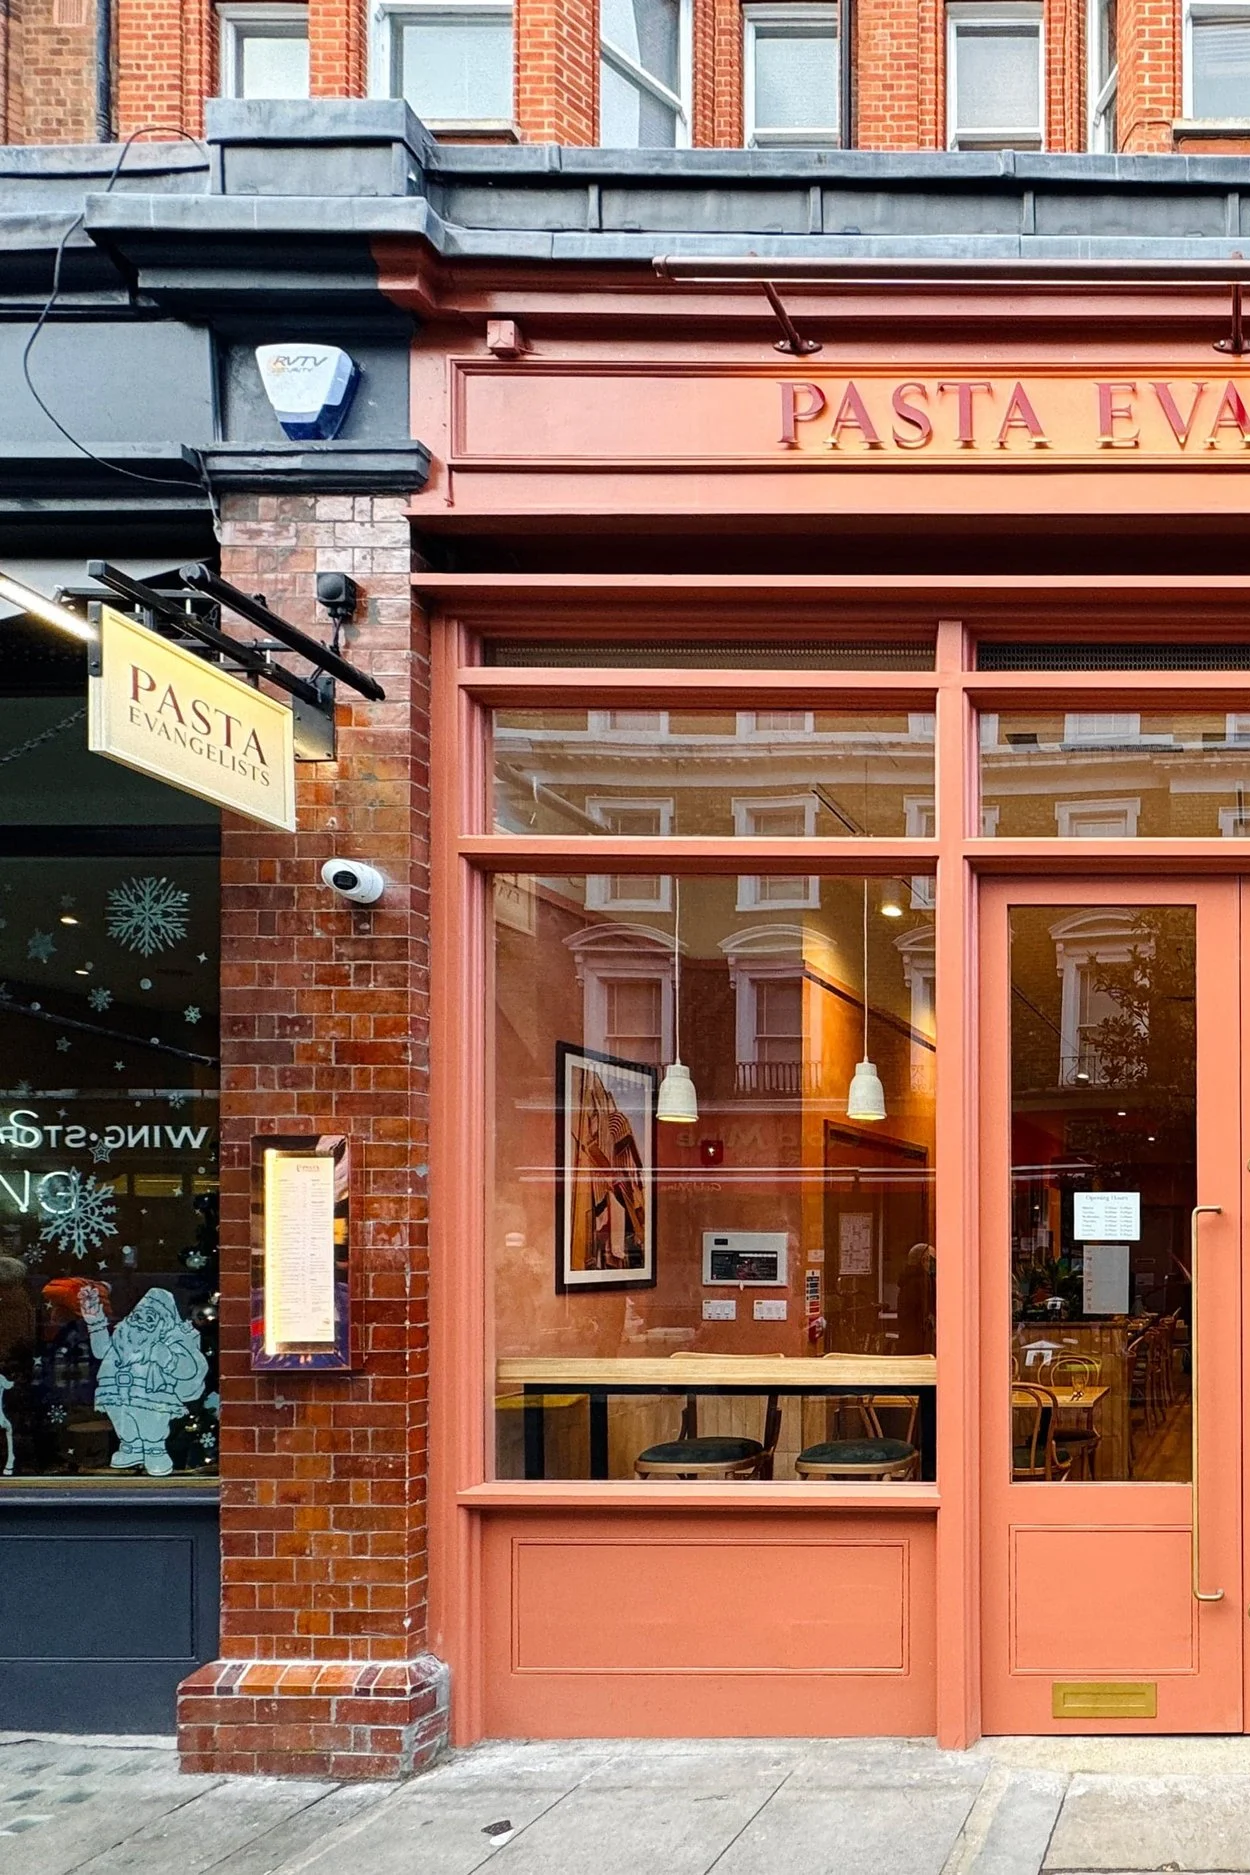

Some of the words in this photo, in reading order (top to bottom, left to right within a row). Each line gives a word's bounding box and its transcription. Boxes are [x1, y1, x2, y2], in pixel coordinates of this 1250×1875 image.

[273, 355, 328, 367] RVTV
[776, 380, 1054, 449] PASTA
[129, 706, 270, 787] EVANGELISTS
[130, 664, 269, 768] PASTA
